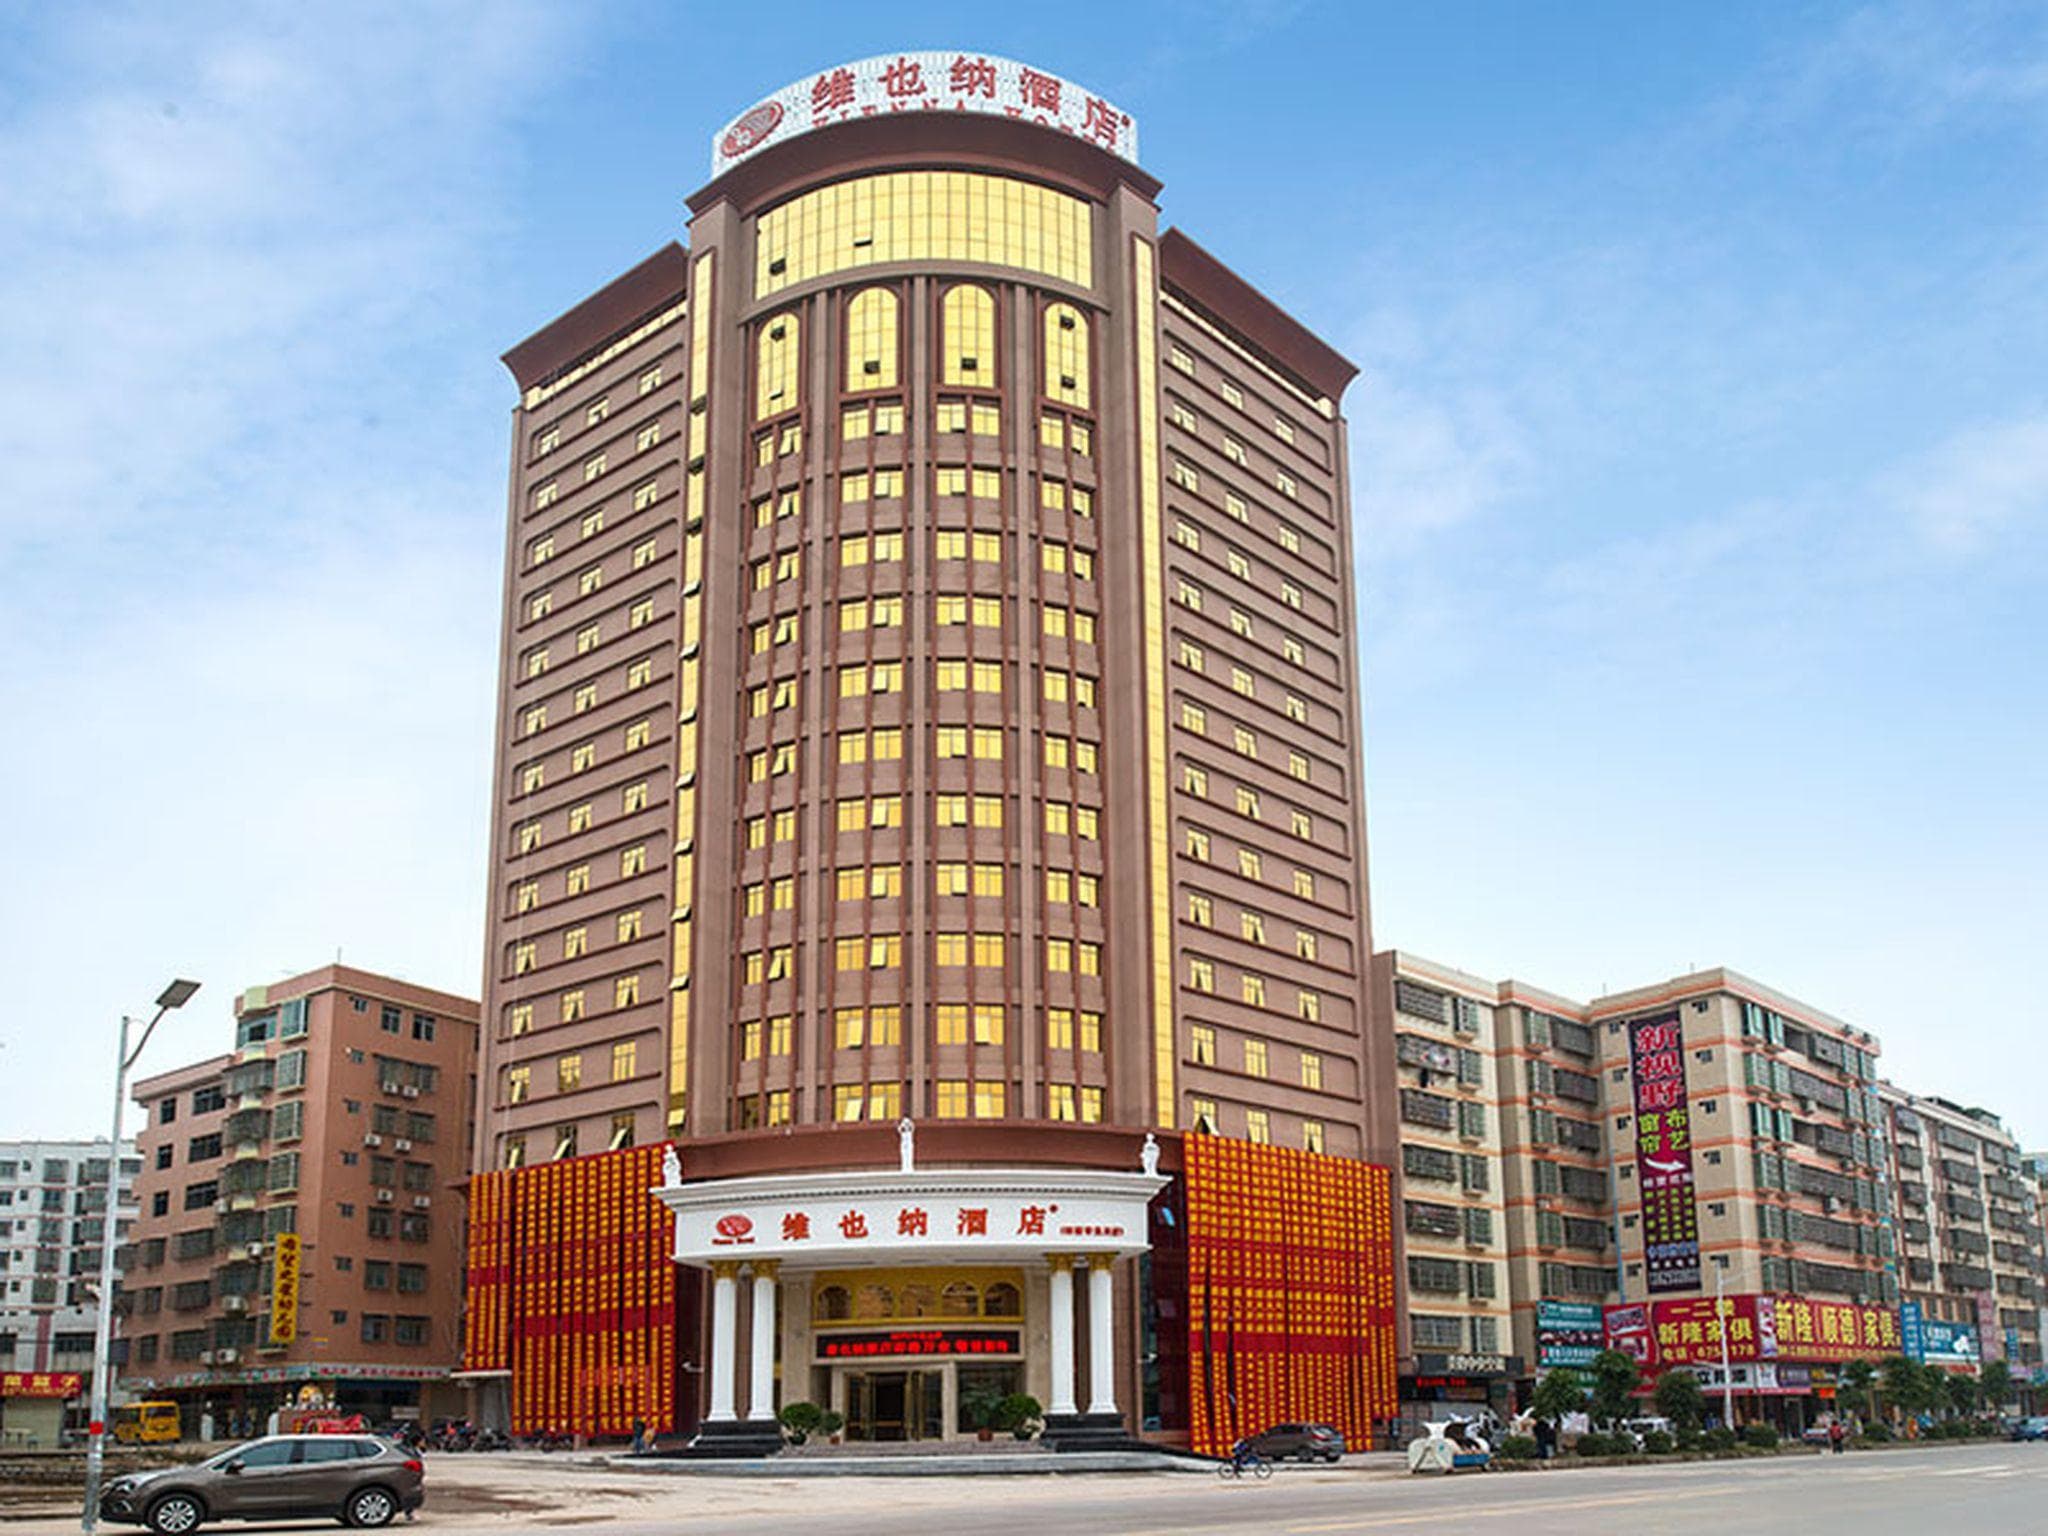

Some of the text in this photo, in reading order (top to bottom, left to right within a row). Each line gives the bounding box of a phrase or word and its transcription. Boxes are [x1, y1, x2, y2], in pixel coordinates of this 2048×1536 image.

[811, 56, 1120, 146] 维也纳酒店
[1636, 1021, 1685, 1108] 新视野
[781, 1205, 1047, 1240] 维也纳酒店
